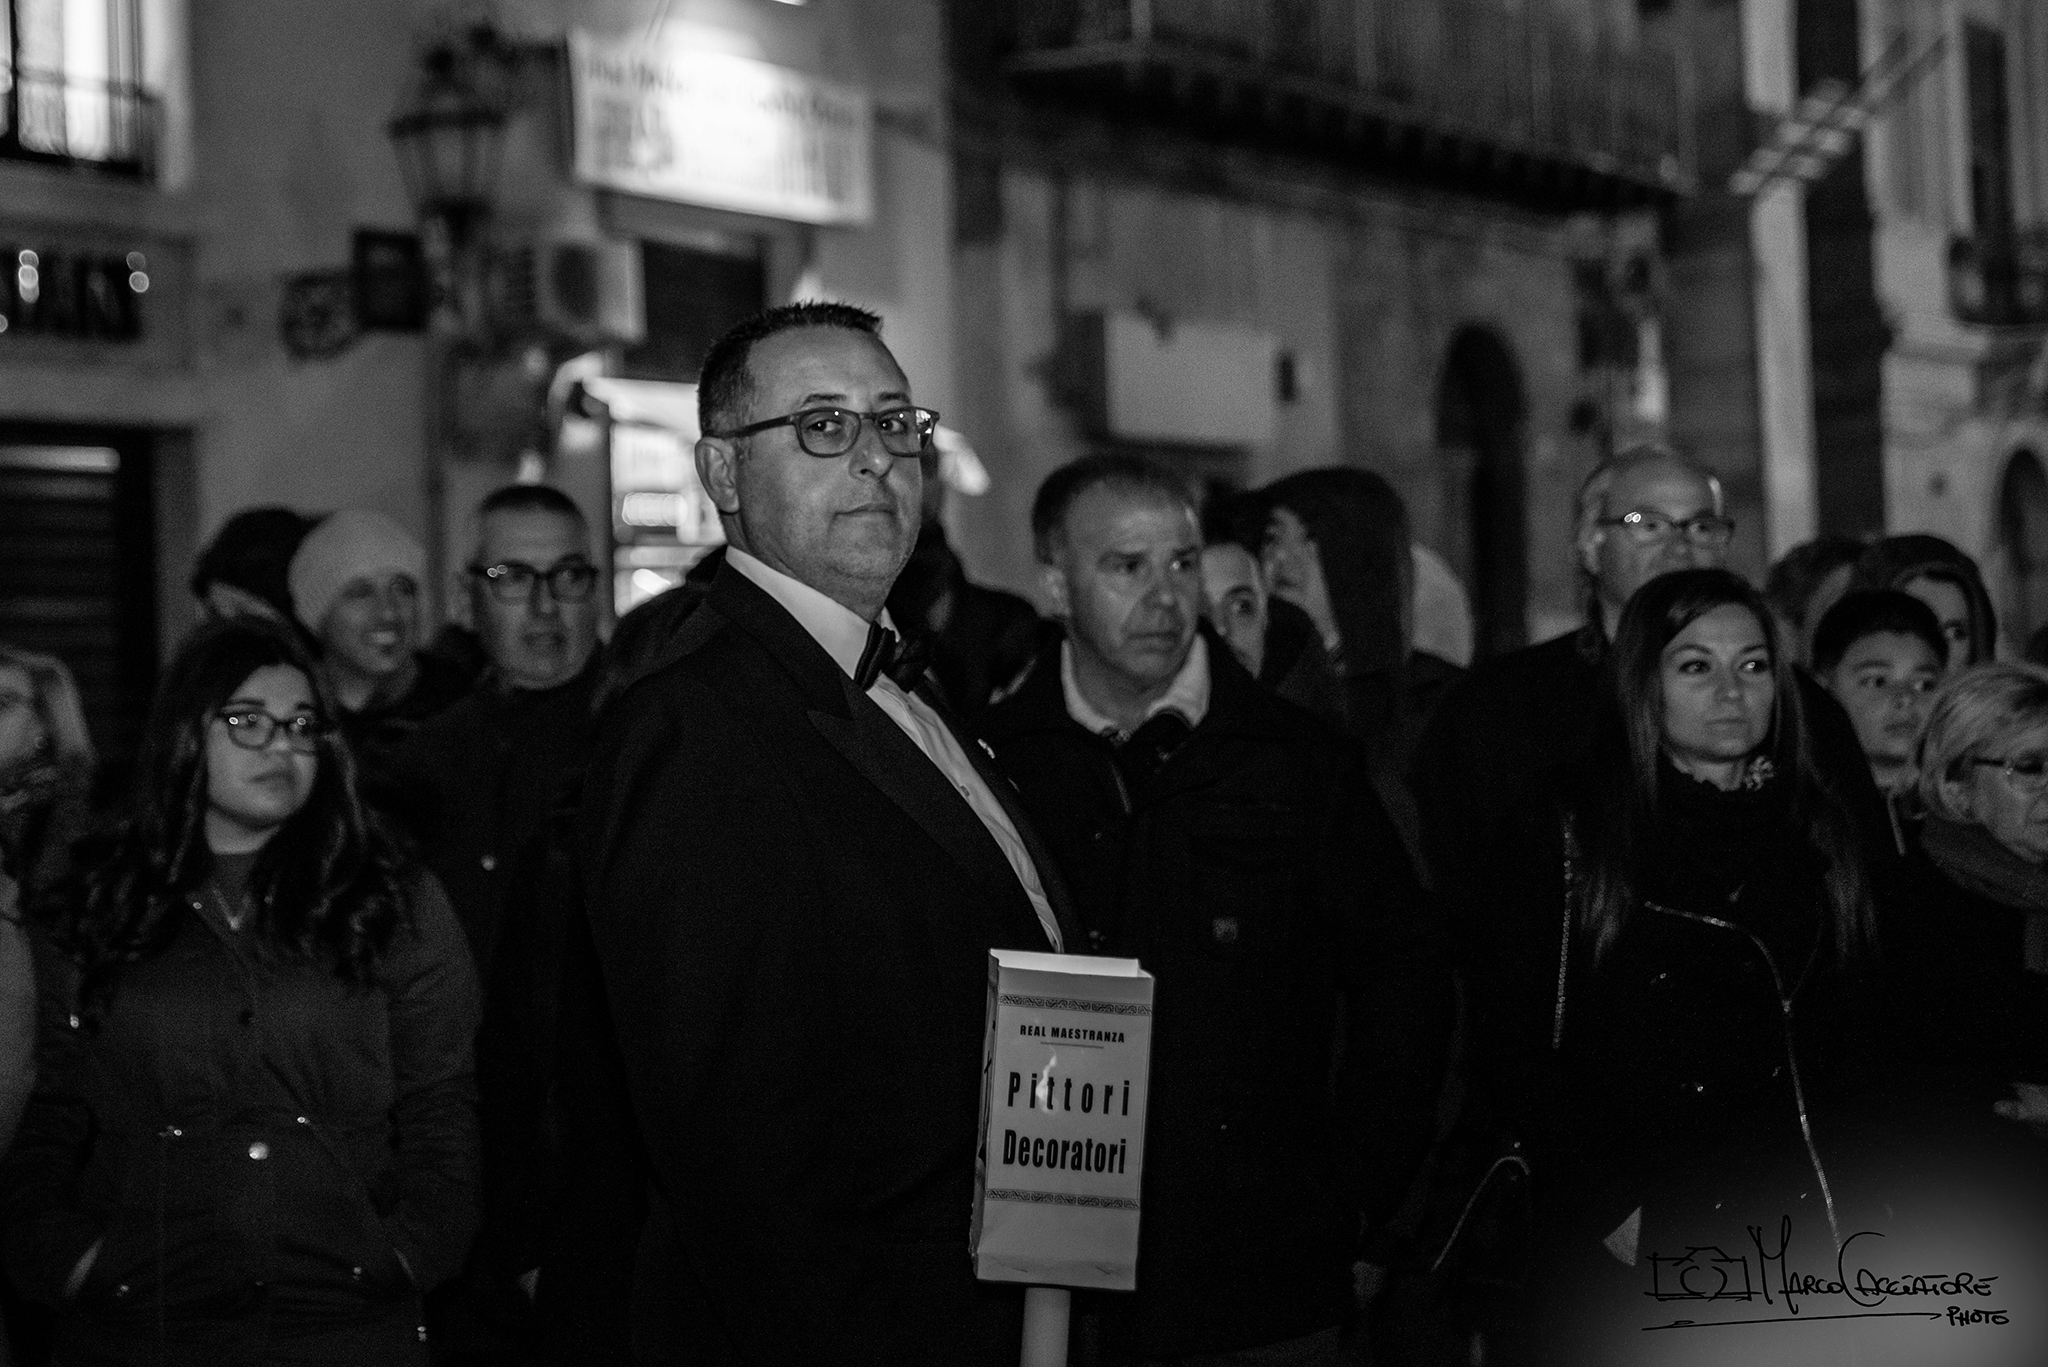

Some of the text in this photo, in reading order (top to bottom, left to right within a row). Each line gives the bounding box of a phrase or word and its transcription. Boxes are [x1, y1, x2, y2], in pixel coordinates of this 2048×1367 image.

[1020, 1024, 1125, 1043] REAL MAESTRANZA
[1007, 1071, 1130, 1116] Pittori
[1003, 1129, 1126, 1174] Decoratori
